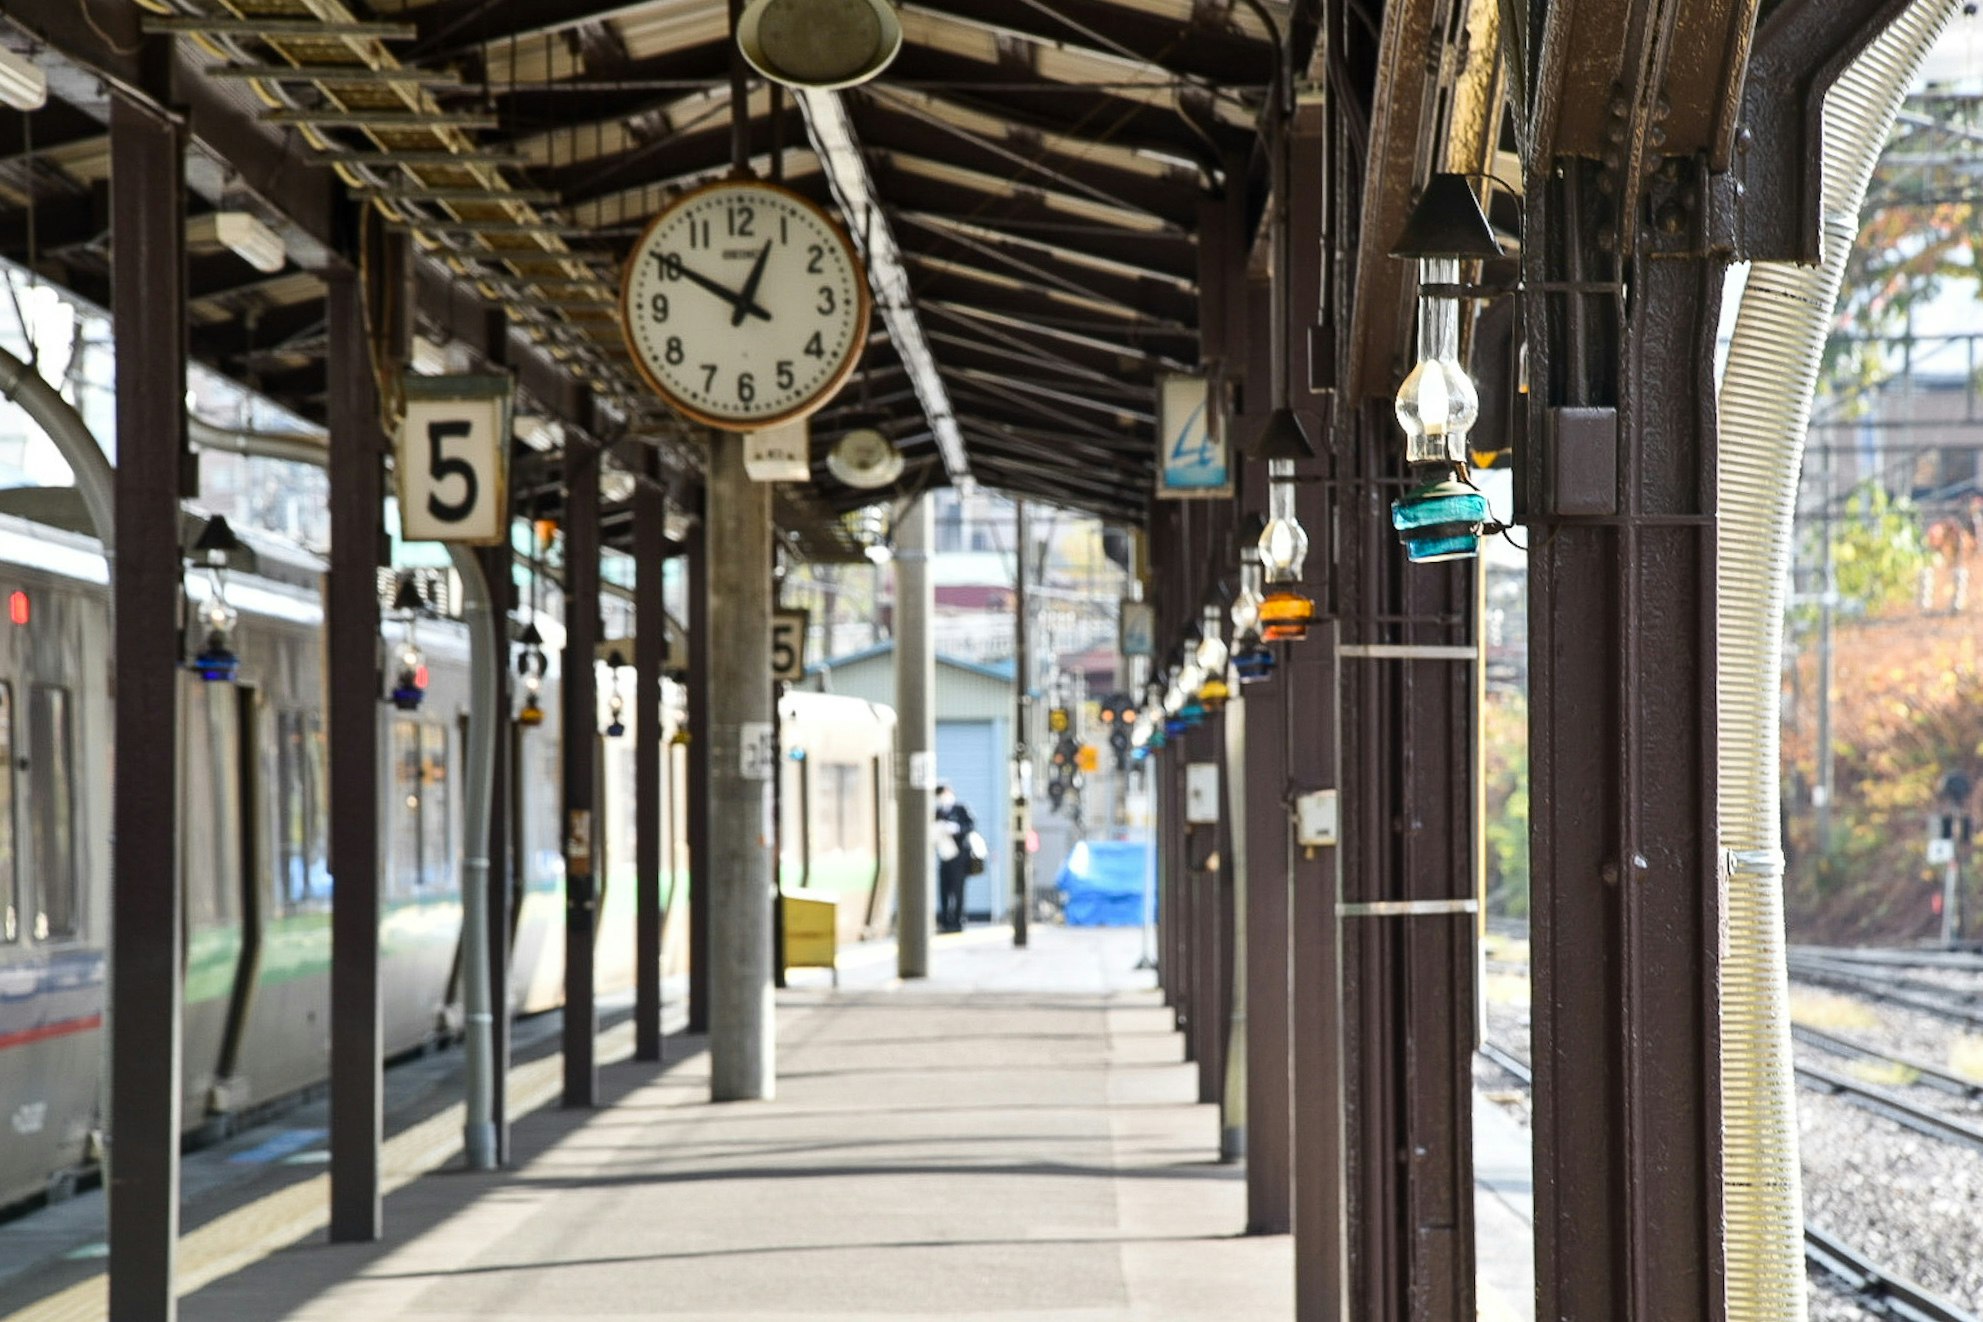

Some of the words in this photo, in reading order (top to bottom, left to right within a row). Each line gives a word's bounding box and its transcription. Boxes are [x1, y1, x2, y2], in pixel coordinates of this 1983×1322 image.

[689, 220, 710, 249] 11
[727, 206, 755, 237] 12
[780, 214, 788, 246] 1
[658, 252, 682, 281] 10
[806, 244, 825, 274] 2
[651, 293, 669, 323] 9
[816, 286, 836, 315] 3
[664, 337, 685, 365] 8
[803, 331, 826, 360] 4
[700, 364, 717, 393] 7
[737, 373, 755, 402] 6
[776, 361, 795, 390] 5
[427, 420, 478, 523] 5
[773, 625, 795, 673] 5
